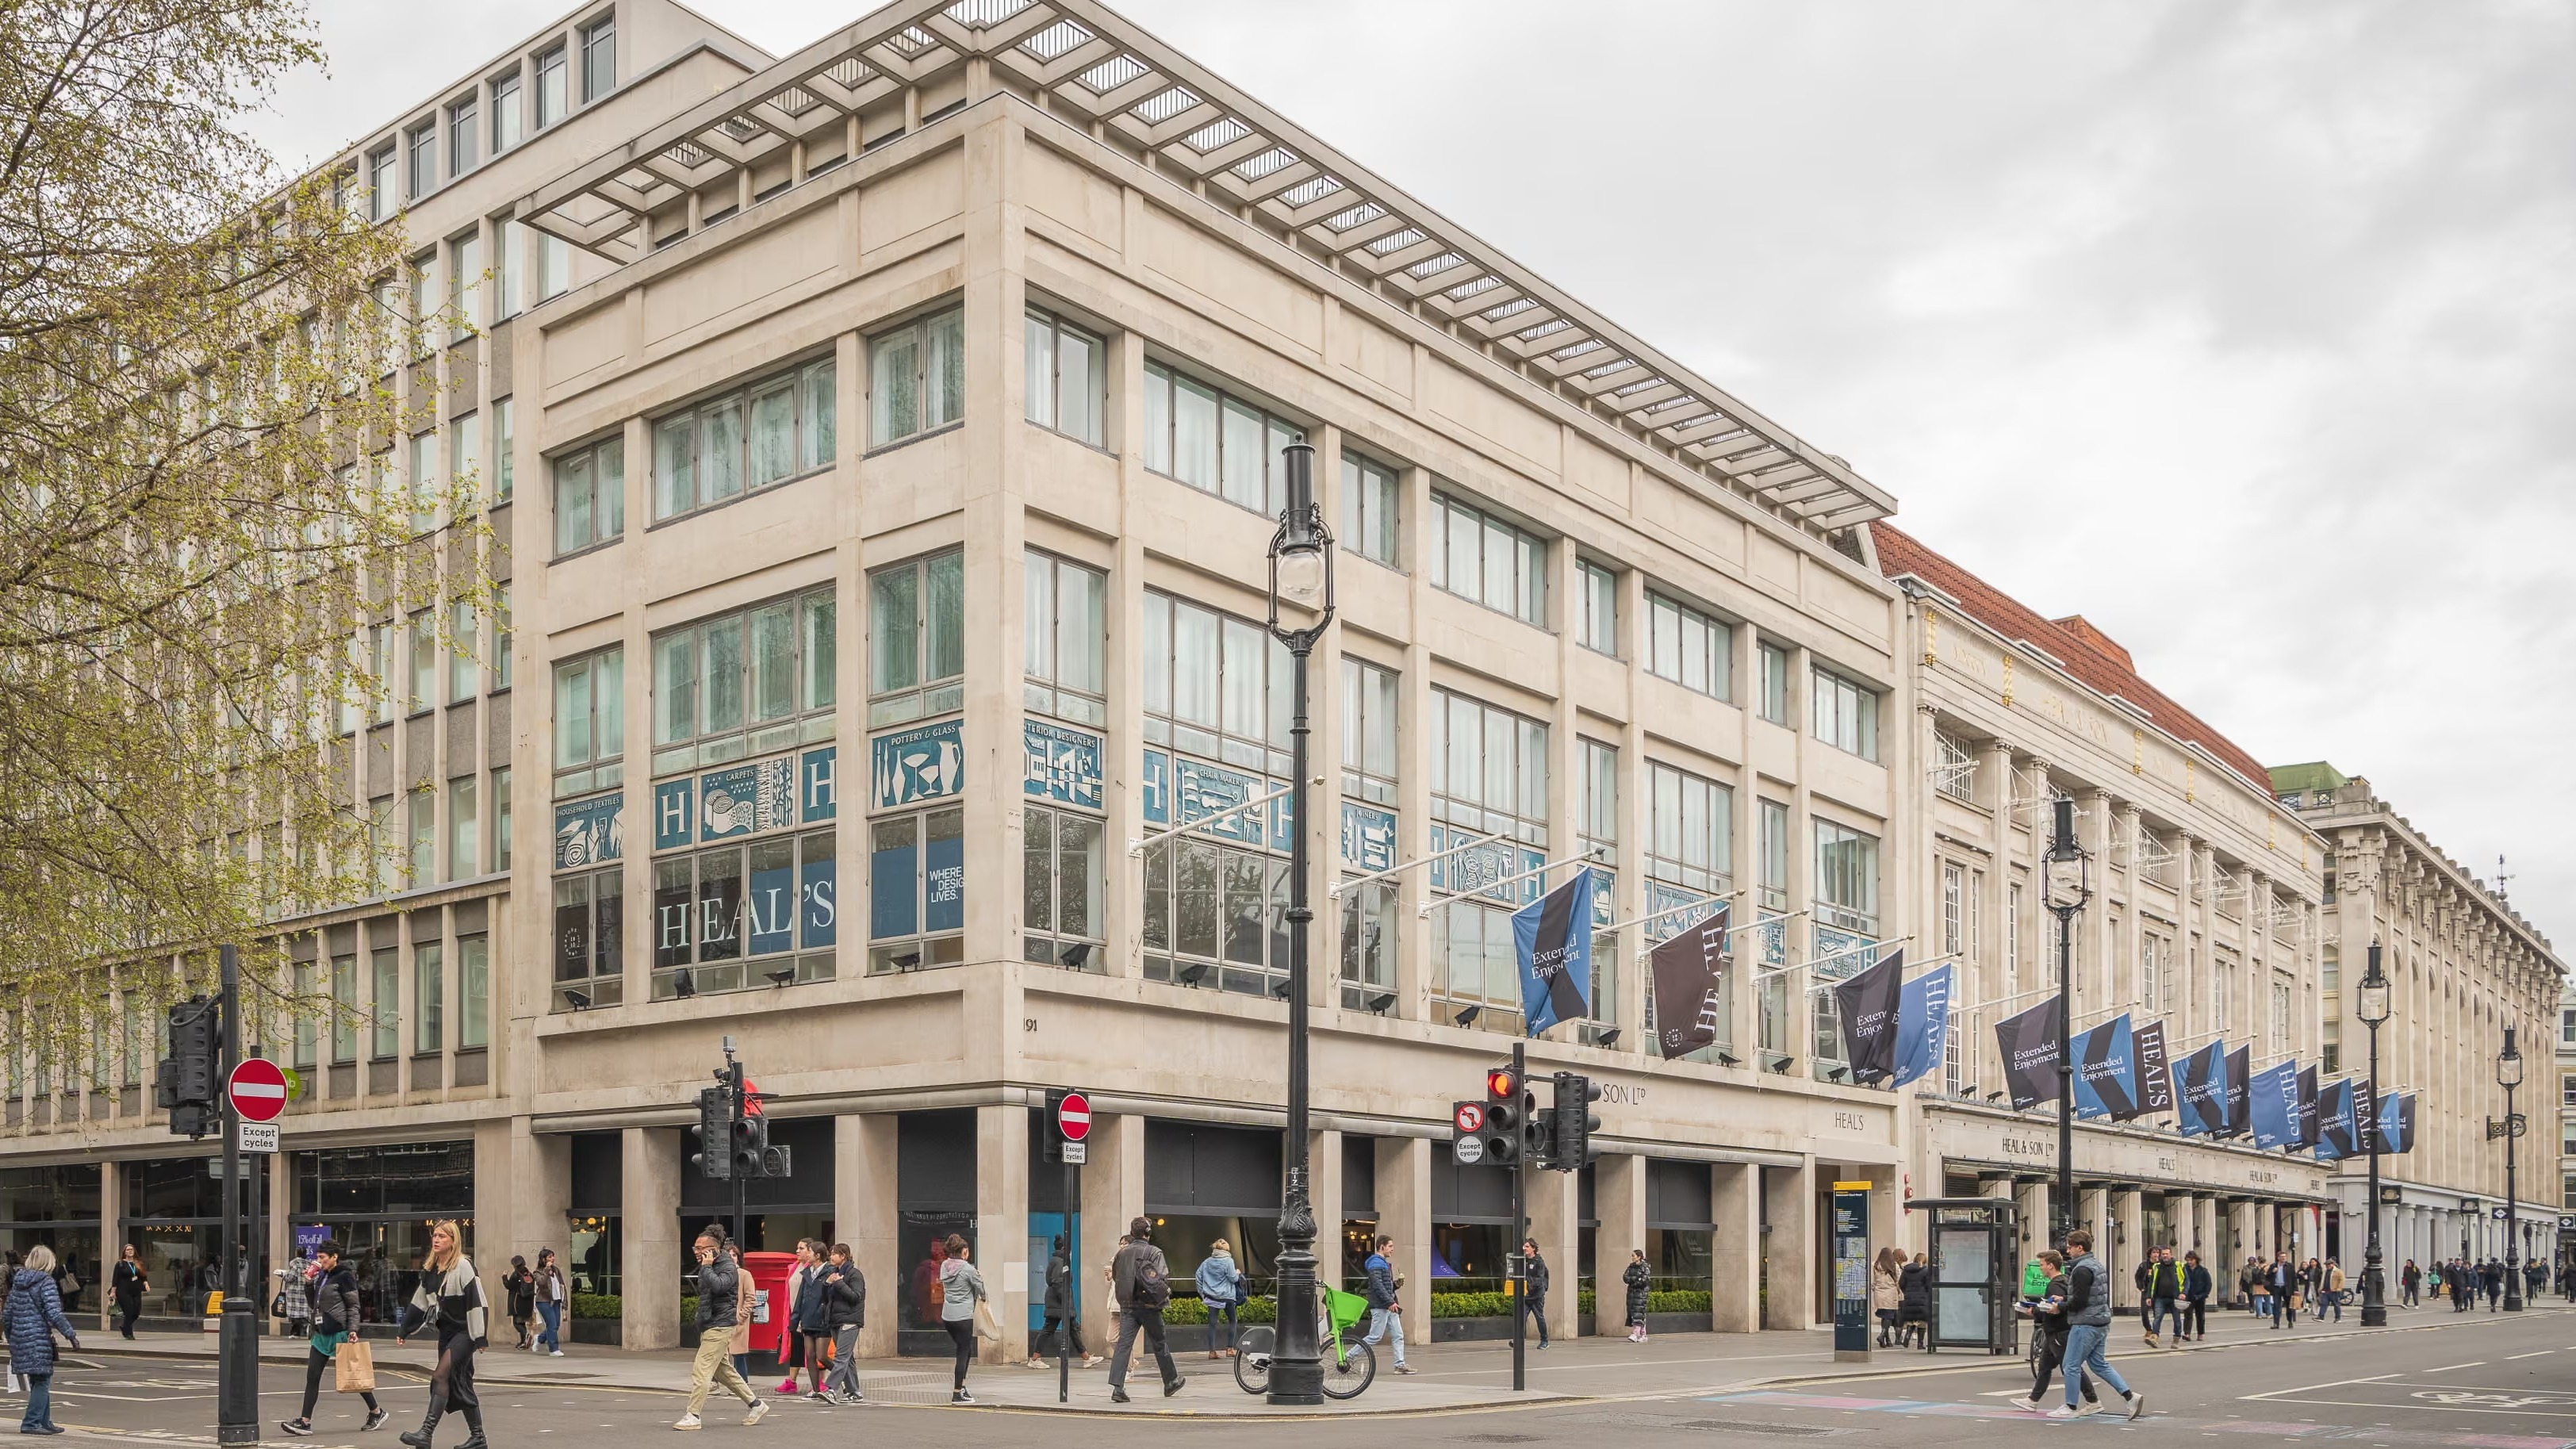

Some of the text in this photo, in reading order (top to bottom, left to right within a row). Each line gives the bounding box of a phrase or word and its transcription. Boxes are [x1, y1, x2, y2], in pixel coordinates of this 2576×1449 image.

[891, 724, 956, 746] POTTERY & GLASS
[1024, 723, 1095, 748] NTERIOR DESIGNERS
[726, 770, 754, 781] CARPETS
[1199, 769, 1243, 787] CHAIR MAKERS
[557, 796, 620, 817] HOUSEHOLD TEXTILES
[661, 791, 686, 837] H
[930, 866, 962, 881] WHERE
[937, 876, 965, 891] DESIG
[930, 889, 959, 903] LIVES.
[658, 880, 834, 950] HEAL'S
[1023, 1017, 1038, 1032] 191
[1926, 976, 1946, 1060] HEALS
[2014, 1040, 2057, 1060] Extended
[2014, 1051, 2060, 1071] Enjoyment
[2081, 1056, 2123, 1073] Extended
[2141, 1029, 2168, 1107] HEAL'S
[2080, 1067, 2126, 1083] Enjoyment
[1603, 1083, 1628, 1104] SON
[2277, 1068, 2299, 1137] HEALS
[1834, 1111, 1864, 1131] HEAL'S
[2320, 1111, 2348, 1125] xtended
[2320, 1119, 2352, 1132] njoyment
[243, 1126, 276, 1138] Except
[243, 1138, 274, 1148] cycles
[2002, 1137, 2020, 1154] HEAL
[2021, 1140, 2027, 1154] &
[2029, 1140, 2044, 1156] SON
